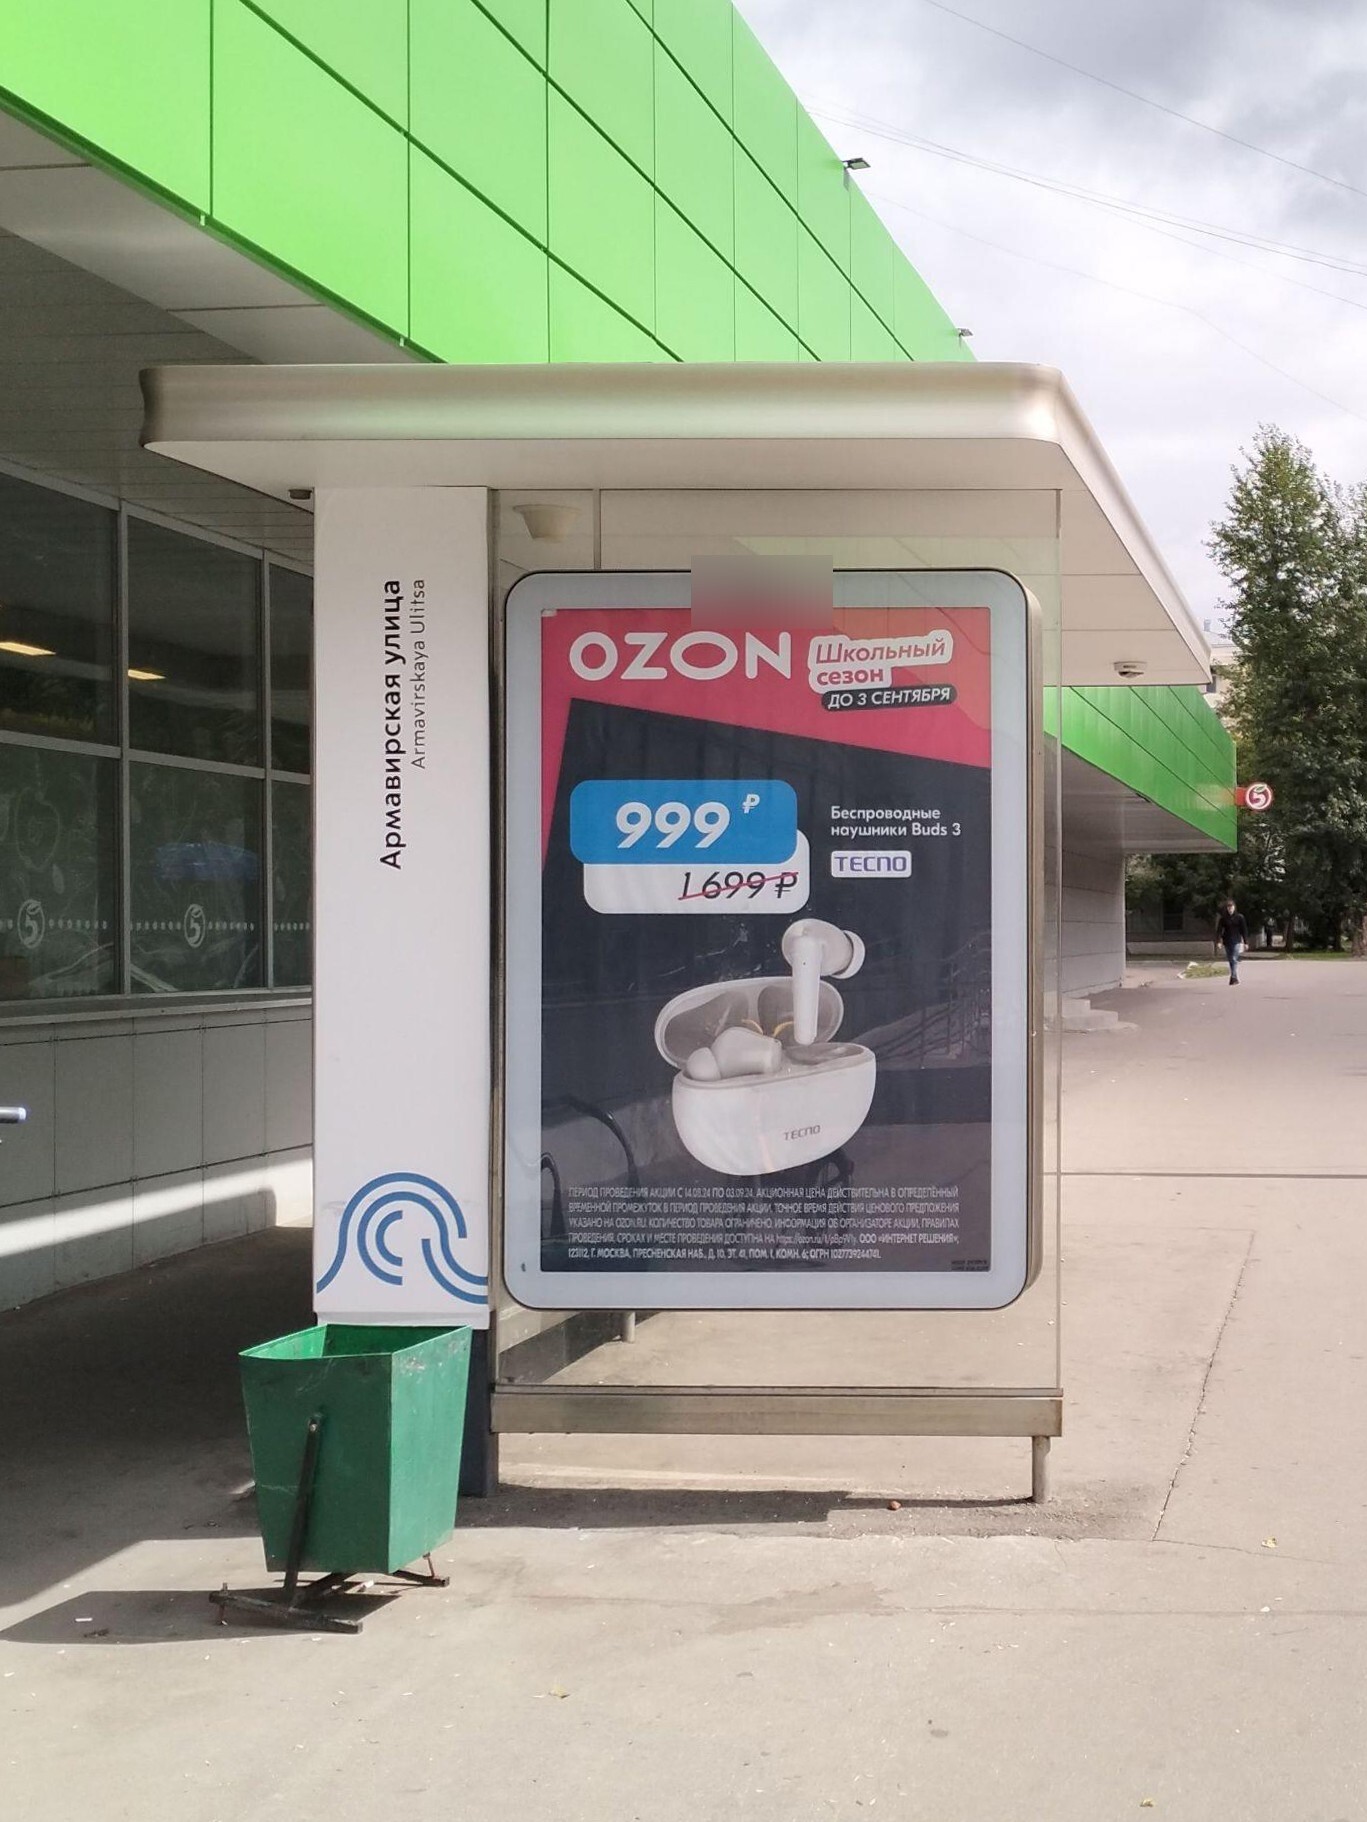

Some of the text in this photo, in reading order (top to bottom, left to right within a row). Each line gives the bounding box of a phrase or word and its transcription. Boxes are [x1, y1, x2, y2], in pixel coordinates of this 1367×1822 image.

[569, 631, 791, 681] OZON
[816, 637, 946, 665] Школьный
[410, 580, 428, 769] Armavirskaya Ulitsa
[817, 668, 884, 686] сезон
[828, 687, 951, 709] ДО 3 СЕНТЯБРЯ
[379, 580, 406, 869] Армавирская улица
[831, 805, 941, 822] Беспроводные
[616, 801, 730, 848] 999
[831, 822, 962, 839] наушники Buds 3
[834, 856, 907, 872] TECNO
[784, 1125, 821, 1141] TECNO
[859, 1232, 877, 1244] ООО
[633, 1247, 687, 1259] ПРЕСНЕНСКАЯ
[809, 1247, 830, 1259] ОГРН
